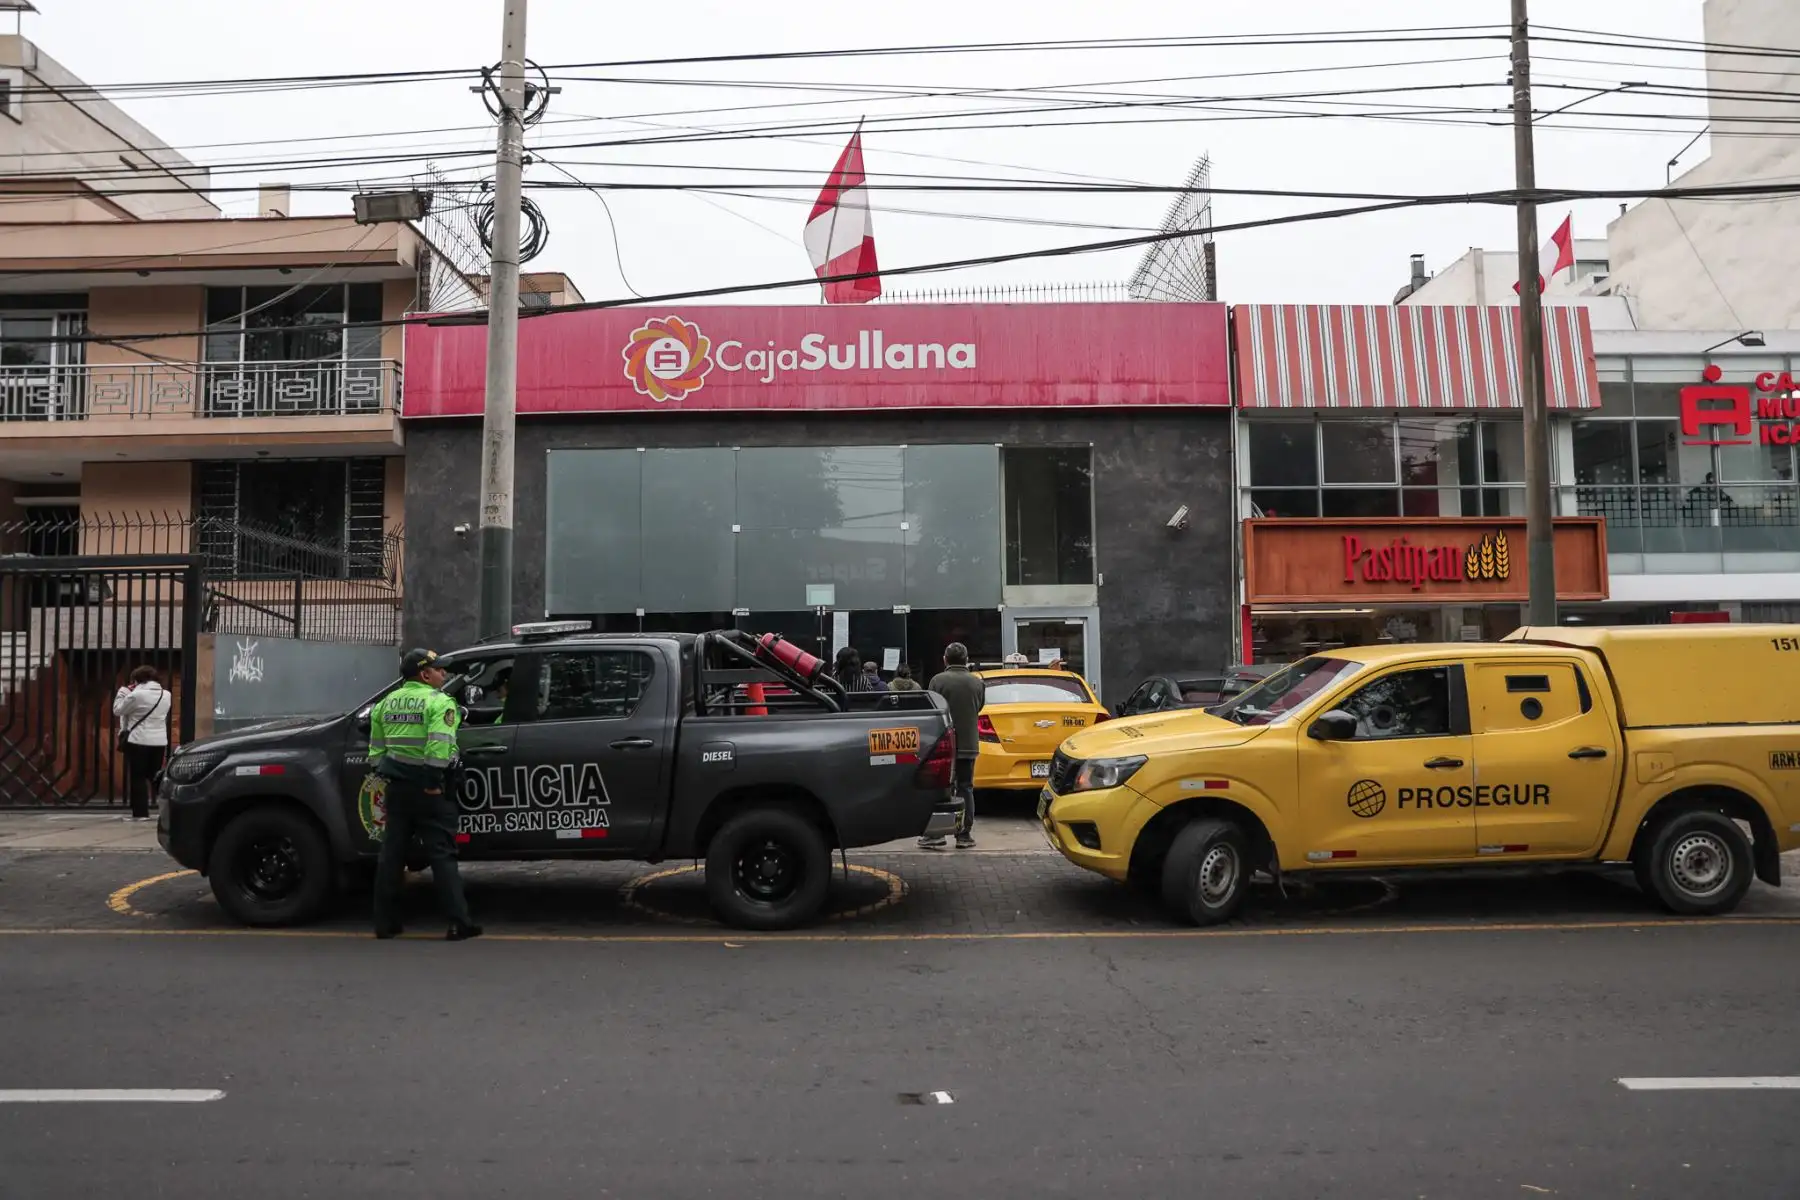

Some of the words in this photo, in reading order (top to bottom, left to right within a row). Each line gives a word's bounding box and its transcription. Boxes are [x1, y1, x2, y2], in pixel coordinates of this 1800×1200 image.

[1755, 372, 1800, 391] CA
[1342, 534, 1464, 590] Pastipan
[1771, 638, 1799, 651] 151
[871, 731, 917, 750] TMP-3052
[702, 751, 733, 762] DIESEL
[457, 763, 611, 810] OLICIA
[1398, 784, 1550, 809] PROSEGUR
[457, 814, 502, 833] PNP.
[505, 811, 543, 832] SAN
[547, 809, 610, 830] BORJA
